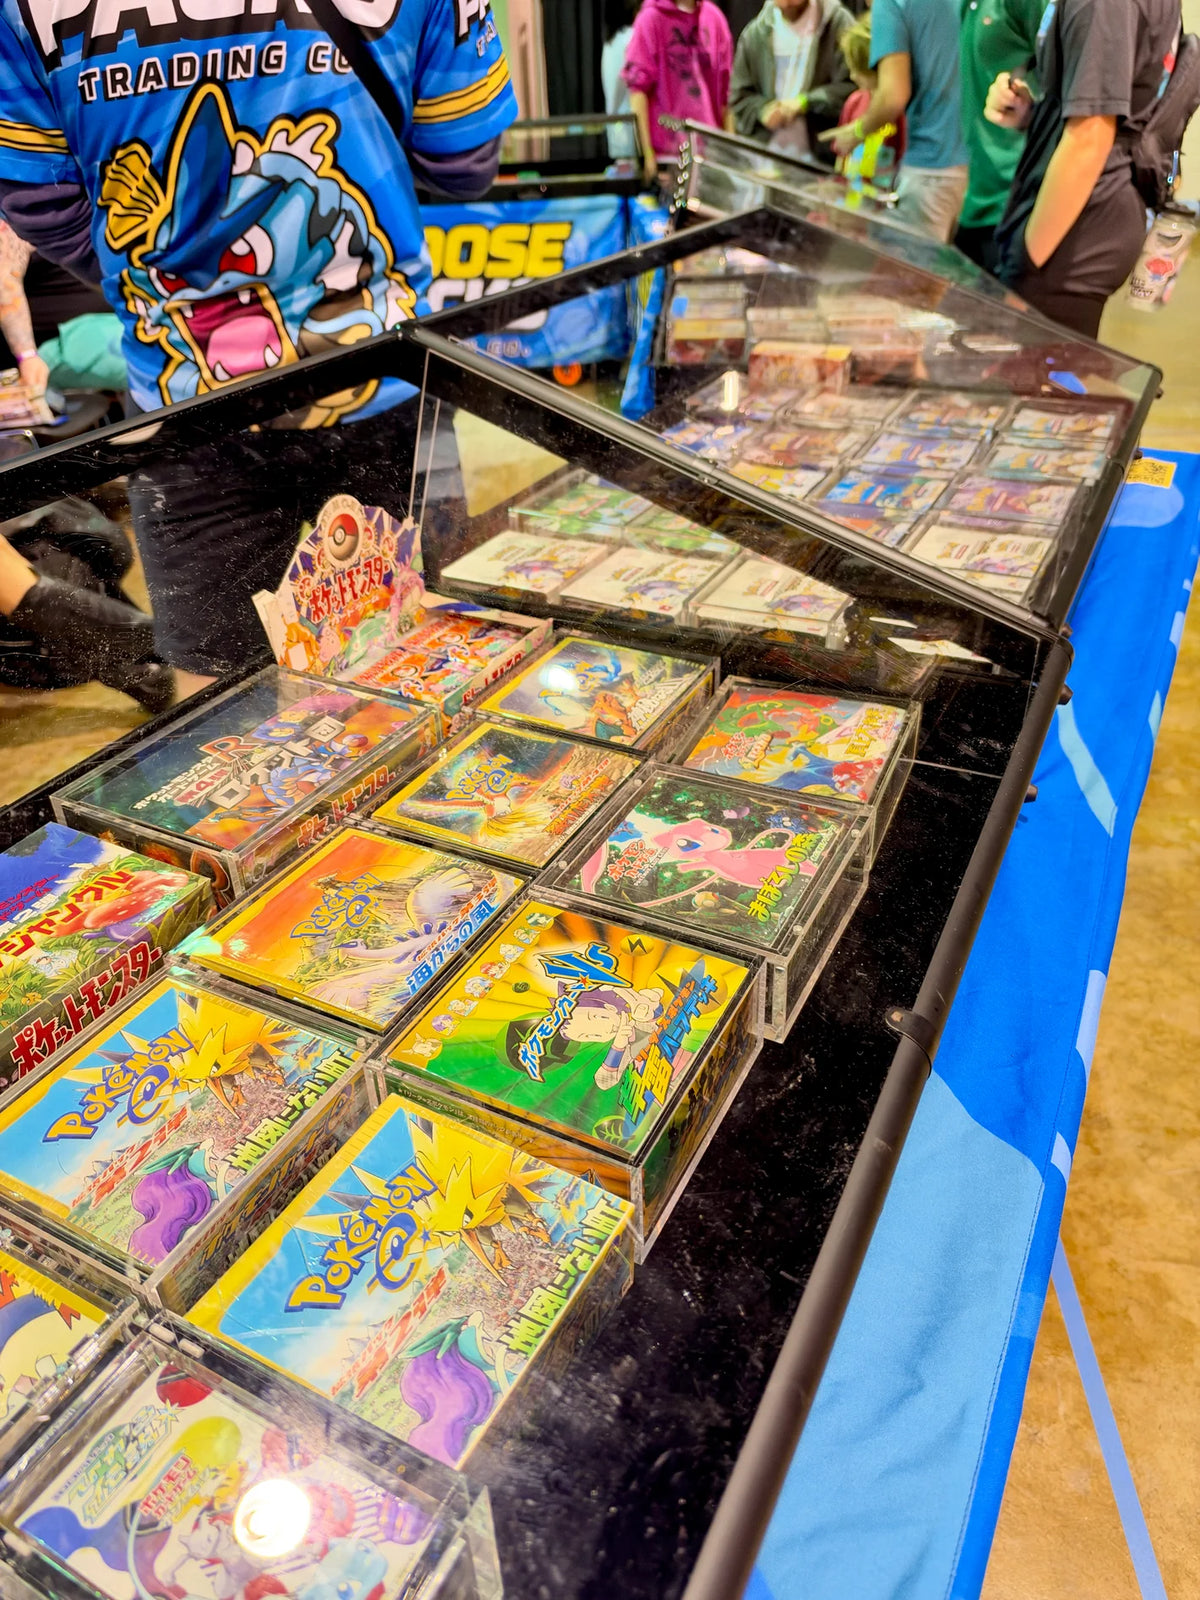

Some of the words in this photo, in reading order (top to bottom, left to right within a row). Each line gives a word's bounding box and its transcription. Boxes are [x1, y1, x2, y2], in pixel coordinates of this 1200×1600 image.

[78, 40, 287, 104] TRADING
[0, 870, 135, 969] ジャングル
[748, 832, 823, 923] まぼろしの森
[405, 897, 500, 997] 海からの風
[536, 943, 633, 989] VS
[9, 940, 163, 1081] ポケットモンスター
[224, 1049, 357, 1173] 地図にない町
[493, 1196, 623, 1358] 地図にない町
